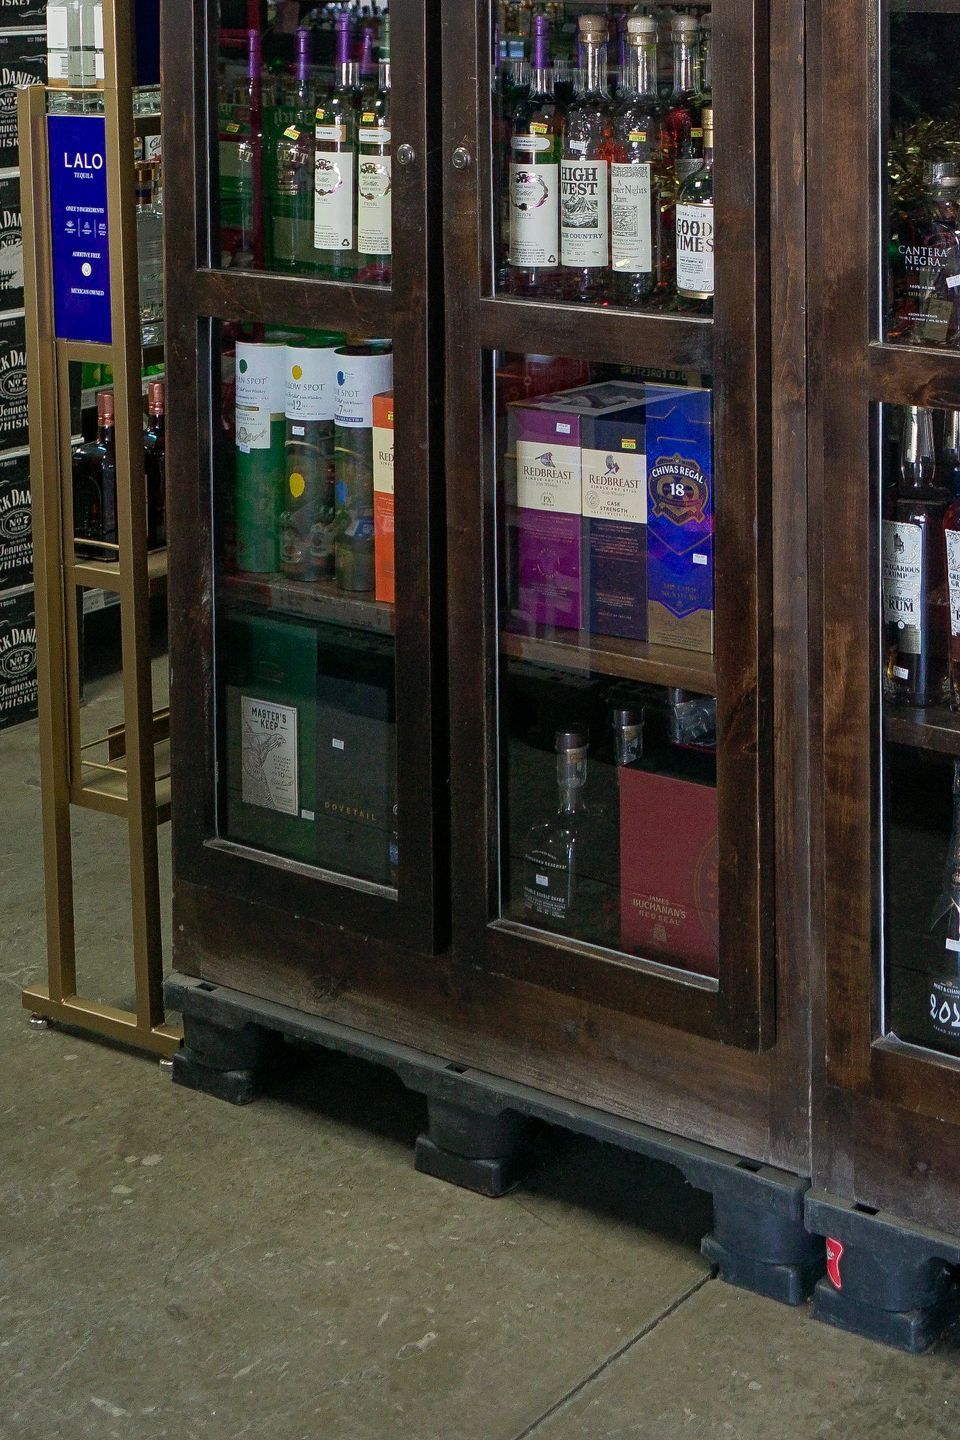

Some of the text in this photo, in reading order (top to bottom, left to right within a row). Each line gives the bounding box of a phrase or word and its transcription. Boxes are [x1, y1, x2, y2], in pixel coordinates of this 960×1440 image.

[64, 152, 103, 169] LALO
[562, 167, 598, 181] HIGH
[562, 183, 598, 195] WEST
[677, 219, 713, 236] GOOD
[898, 245, 947, 258] CANTERA
[905, 256, 941, 267] NEGRA
[292, 400, 302, 410] 12
[523, 465, 574, 481] REDBREAST
[651, 465, 704, 485] CHIVAS REGAL
[589, 474, 641, 489] REDBREAST
[669, 483, 685, 496] 18
[889, 600, 914, 612] RUM
[251, 707, 287, 724] MASTER'S
[260, 719, 279, 732] KEEP
[324, 801, 377, 821] DOVETAIL
[632, 898, 687, 919] BUCHANAN'S
